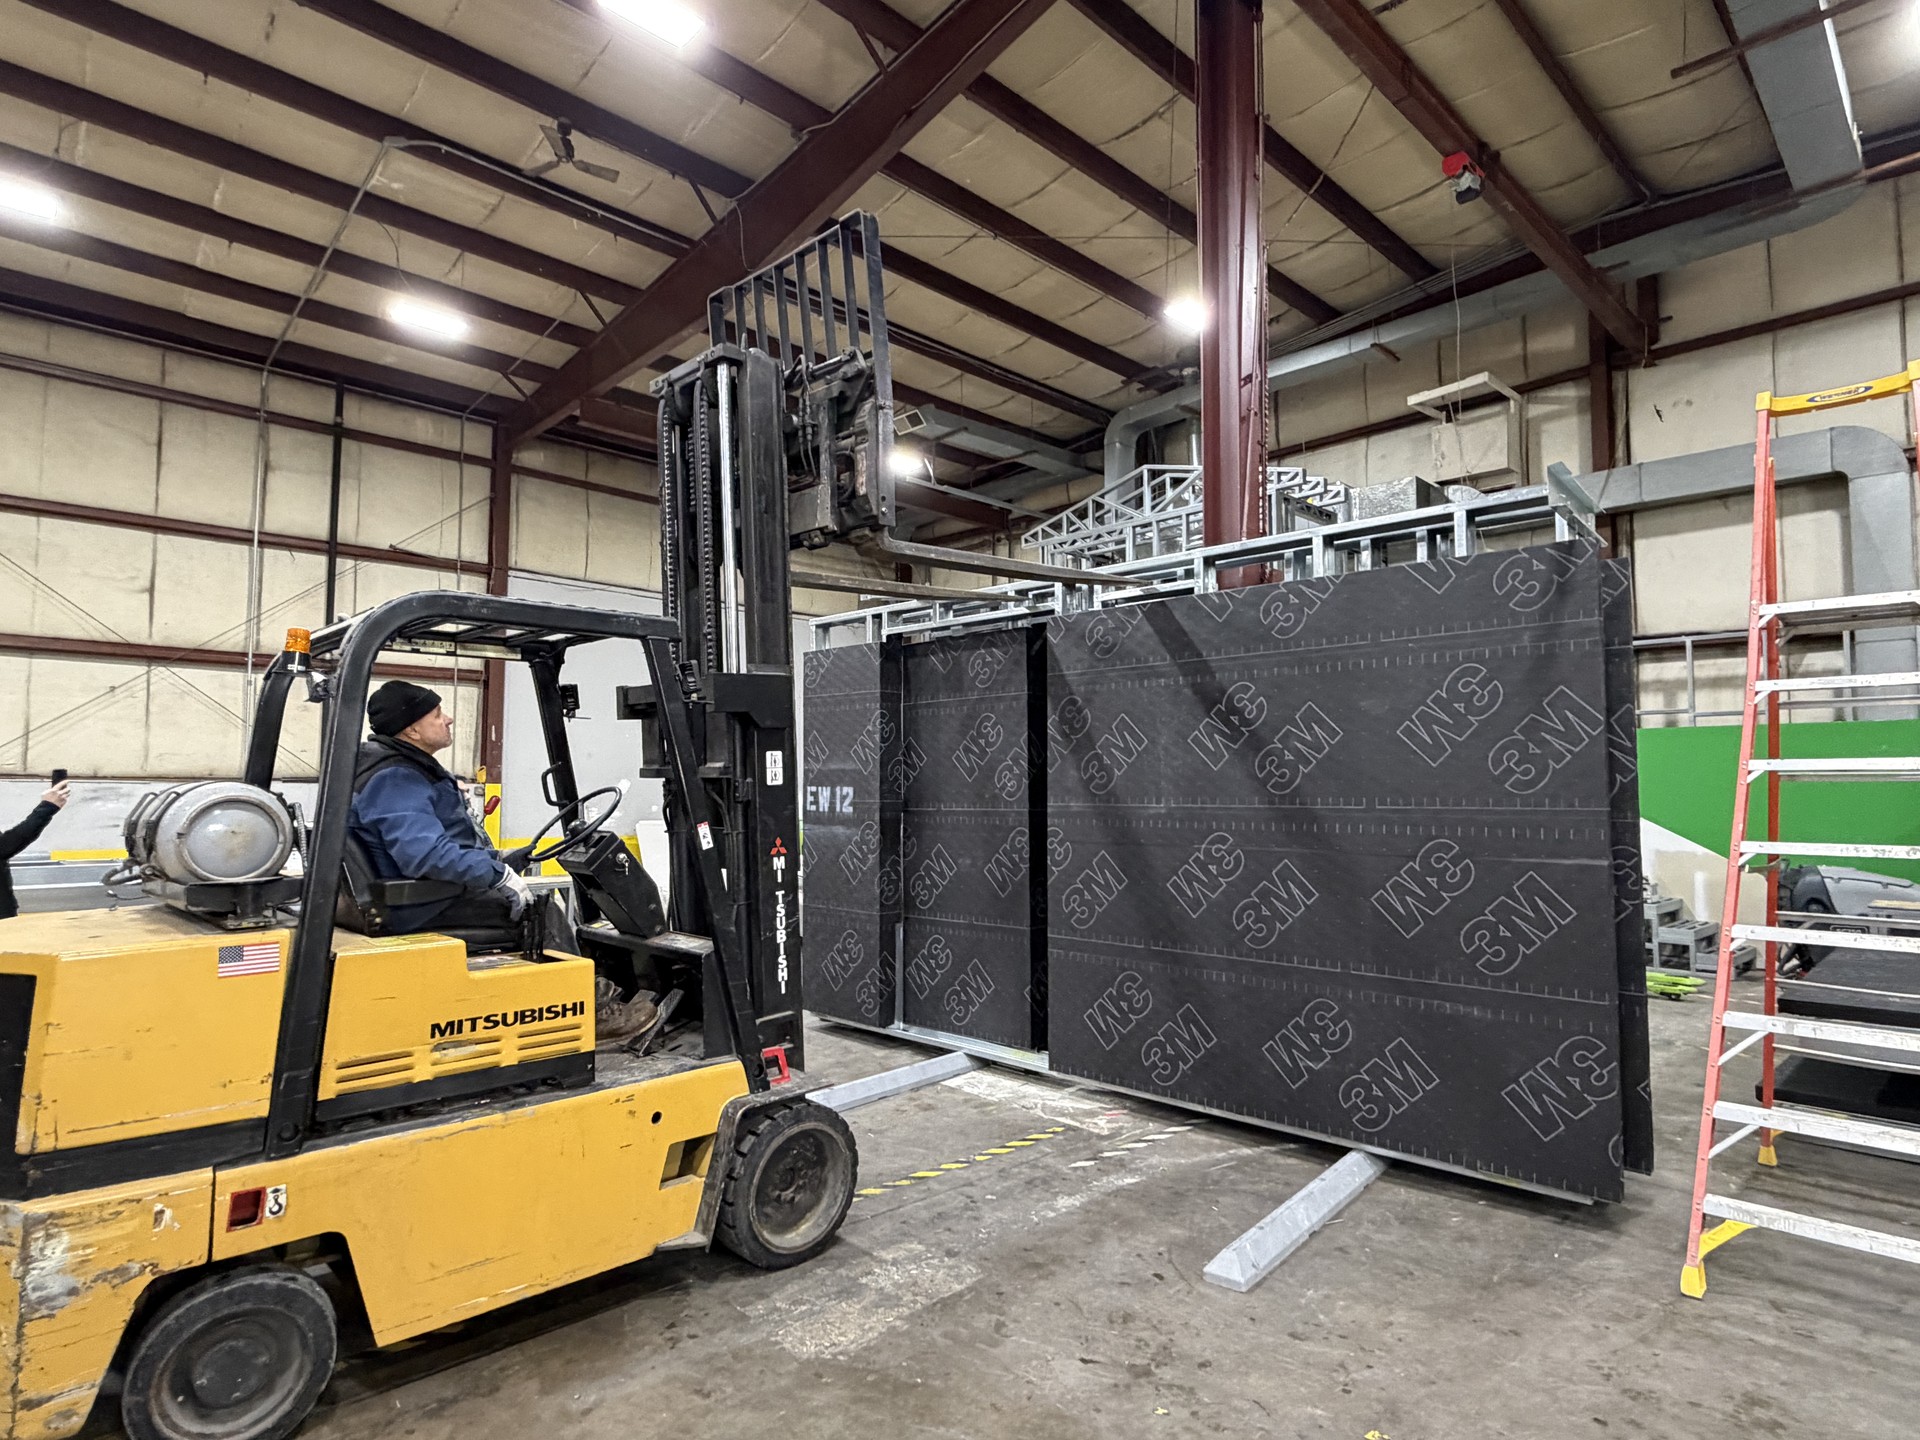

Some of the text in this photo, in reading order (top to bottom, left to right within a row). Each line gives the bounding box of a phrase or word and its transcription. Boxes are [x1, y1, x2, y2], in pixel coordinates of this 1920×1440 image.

[851, 710, 895, 775] 3M
[952, 712, 1003, 782] 3M
[1081, 713, 1148, 795] 3M
[1188, 682, 1267, 771] 3M
[1255, 701, 1344, 794] 3M
[1397, 663, 1503, 767] 3M
[1488, 685, 1605, 794] 3M
[806, 786, 854, 813] EW 12
[838, 821, 882, 885] 3M
[910, 843, 957, 909] 3M
[1062, 850, 1129, 929] 3M
[1166, 832, 1245, 919] 3M
[1371, 839, 1475, 938] 3M
[1233, 859, 1319, 949] 3M
[1460, 871, 1577, 976] 3M
[821, 930, 864, 991] 3M
[856, 952, 896, 1017] 3M
[906, 934, 952, 999] 3M
[944, 959, 995, 1026] 3M
[430, 1001, 585, 1039] MITSUBISHI
[1084, 971, 1152, 1050] 3M
[1141, 1004, 1218, 1086] 3M
[1262, 998, 1353, 1089] 3M
[1339, 1037, 1440, 1132] 3M
[1501, 1035, 1620, 1142] 3M
